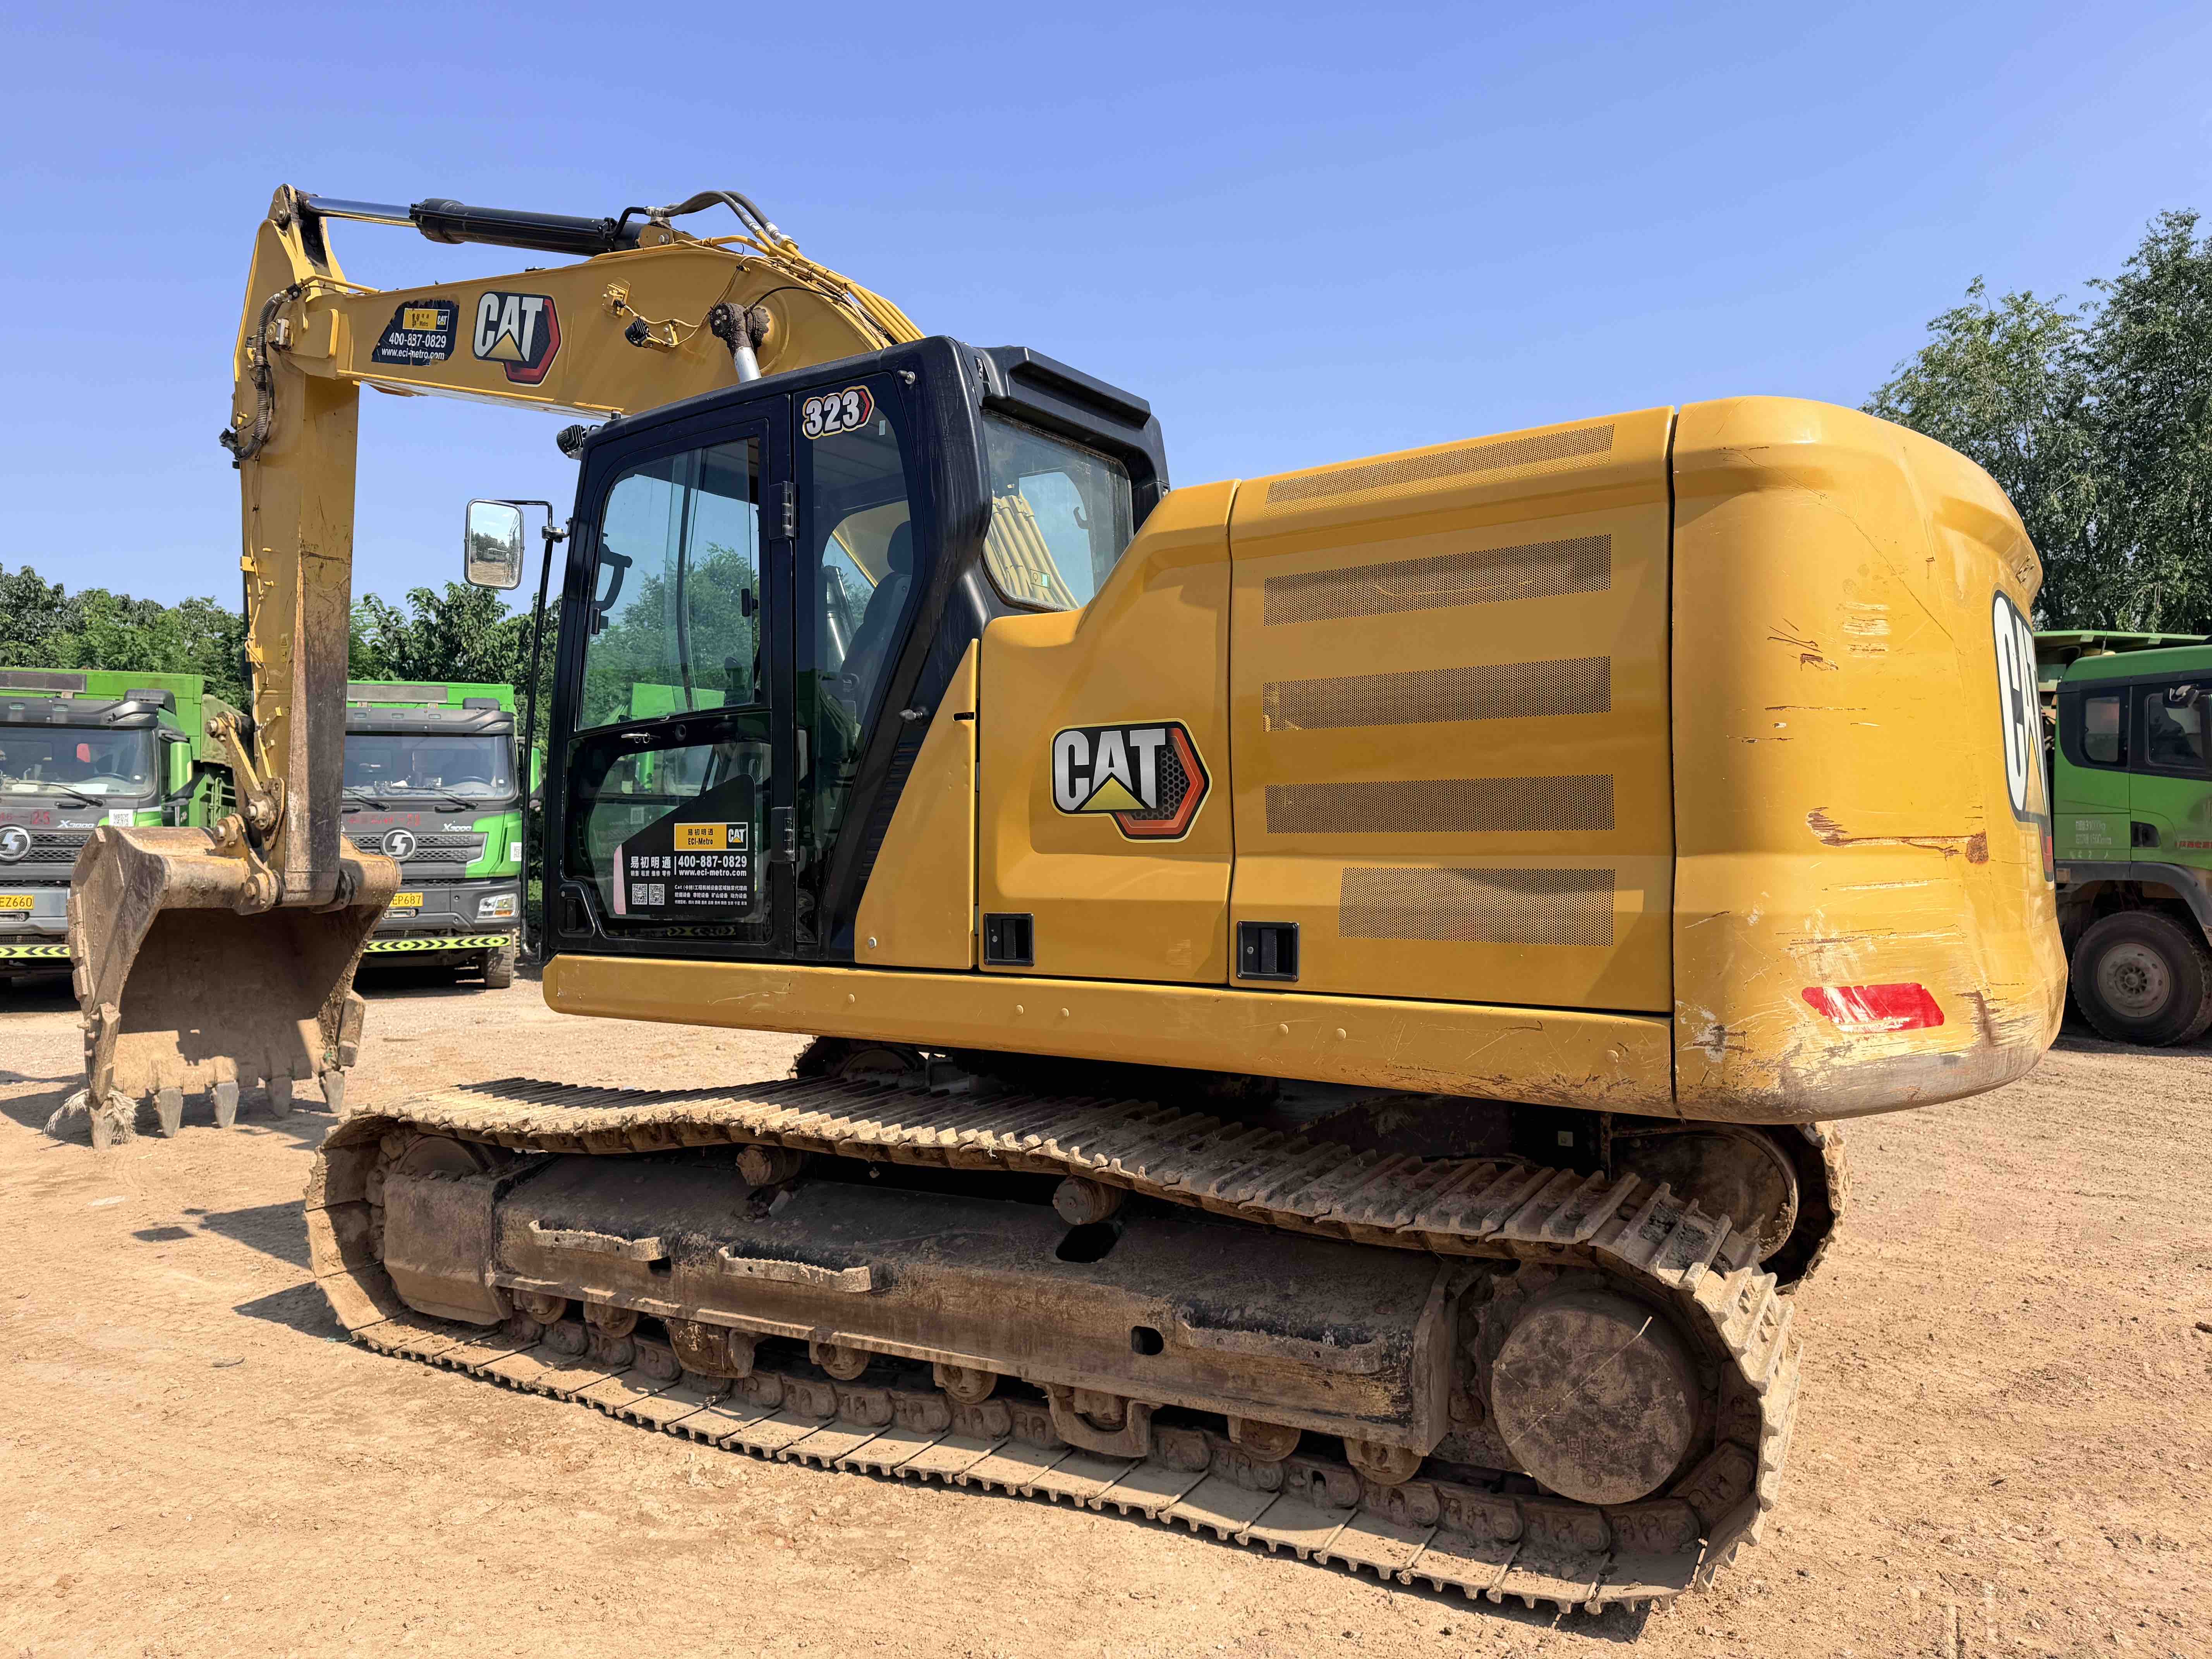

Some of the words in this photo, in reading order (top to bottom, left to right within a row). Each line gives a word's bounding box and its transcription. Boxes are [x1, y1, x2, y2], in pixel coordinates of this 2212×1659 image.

[437, 315, 448, 325] CAT
[474, 293, 543, 362] CAT
[806, 391, 860, 434] 323
[1994, 597, 2047, 816] CAT
[1054, 728, 1165, 811] CAT
[728, 828, 745, 843] CAT
[630, 856, 671, 869] 易初明通
[678, 855, 747, 867] 400-887-0829
[679, 868, 747, 876] www.eci-metro.com
[0, 897, 32, 907] EZ660
[393, 895, 421, 905] EP687
